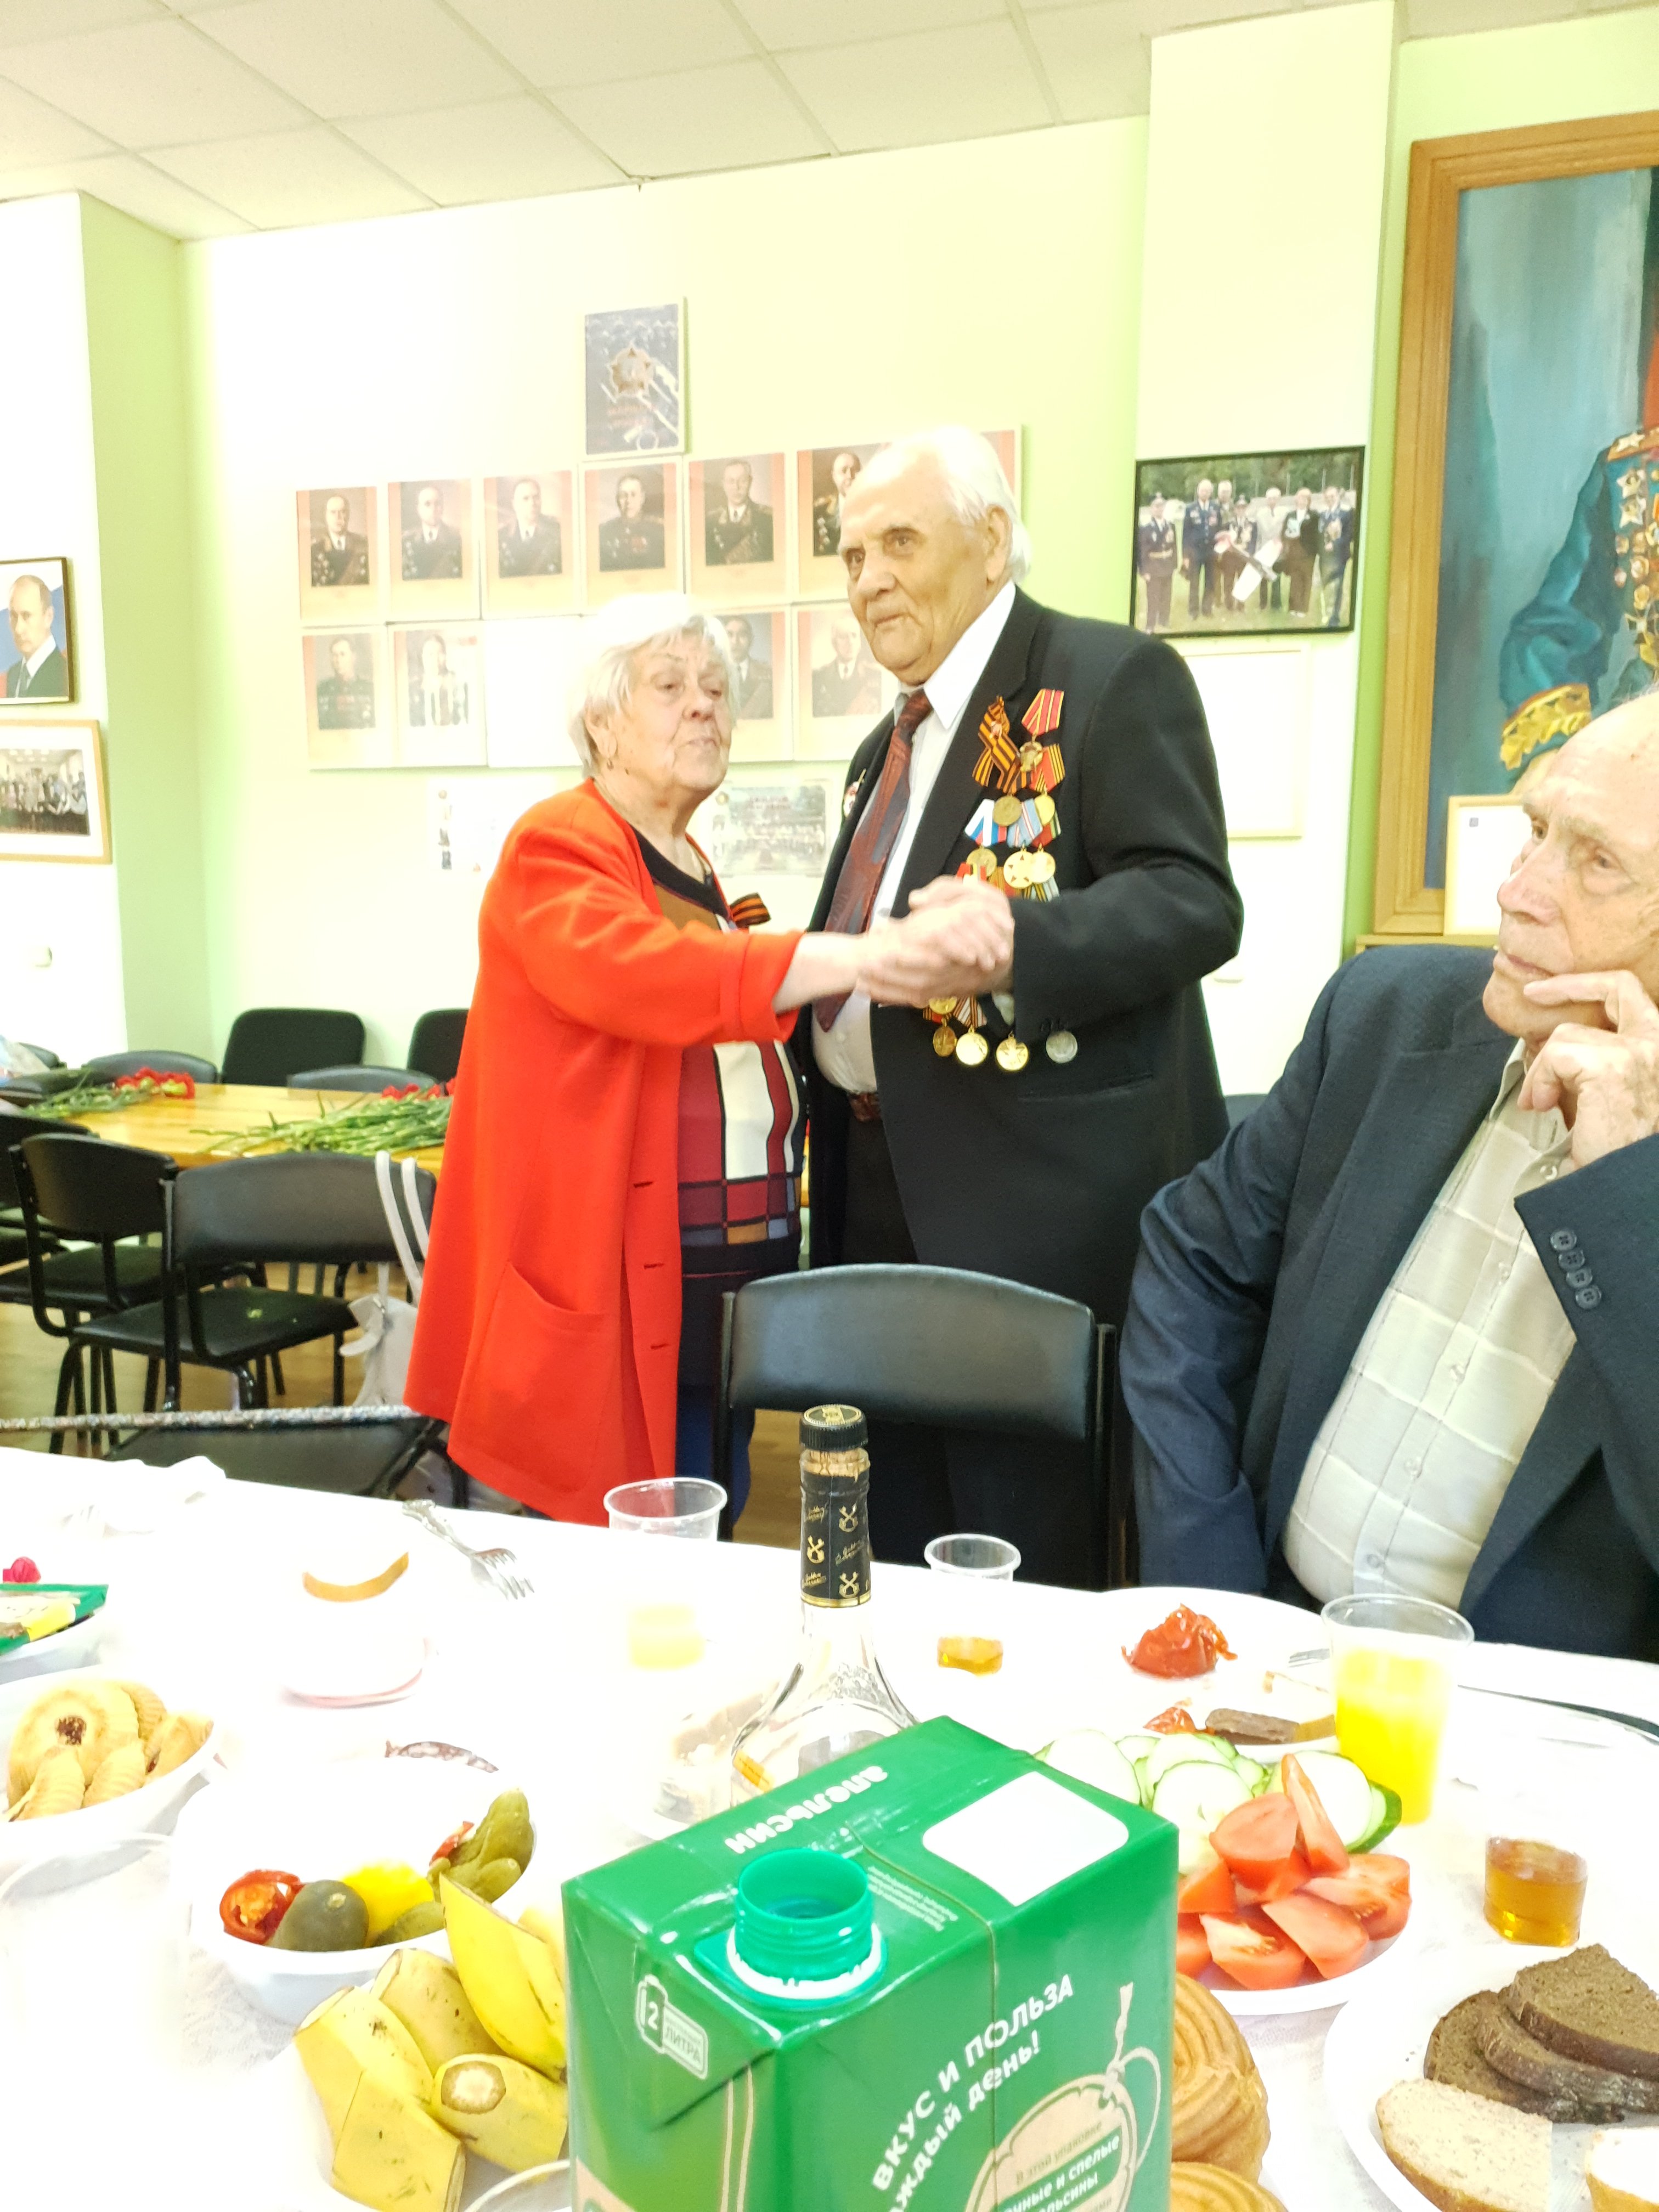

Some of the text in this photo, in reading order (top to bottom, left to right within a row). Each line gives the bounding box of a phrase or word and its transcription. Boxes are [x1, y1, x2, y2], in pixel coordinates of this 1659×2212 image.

[724, 1765, 888, 1854] апельсин
[648, 2001, 658, 2031] 2
[664, 2024, 701, 2064] ЛИТРА
[871, 1974, 1074, 2191] ВКУС И ПОЛЬЗА
[889, 2029, 1040, 2212] ждый день!
[1068, 2135, 1120, 2181] спелые
